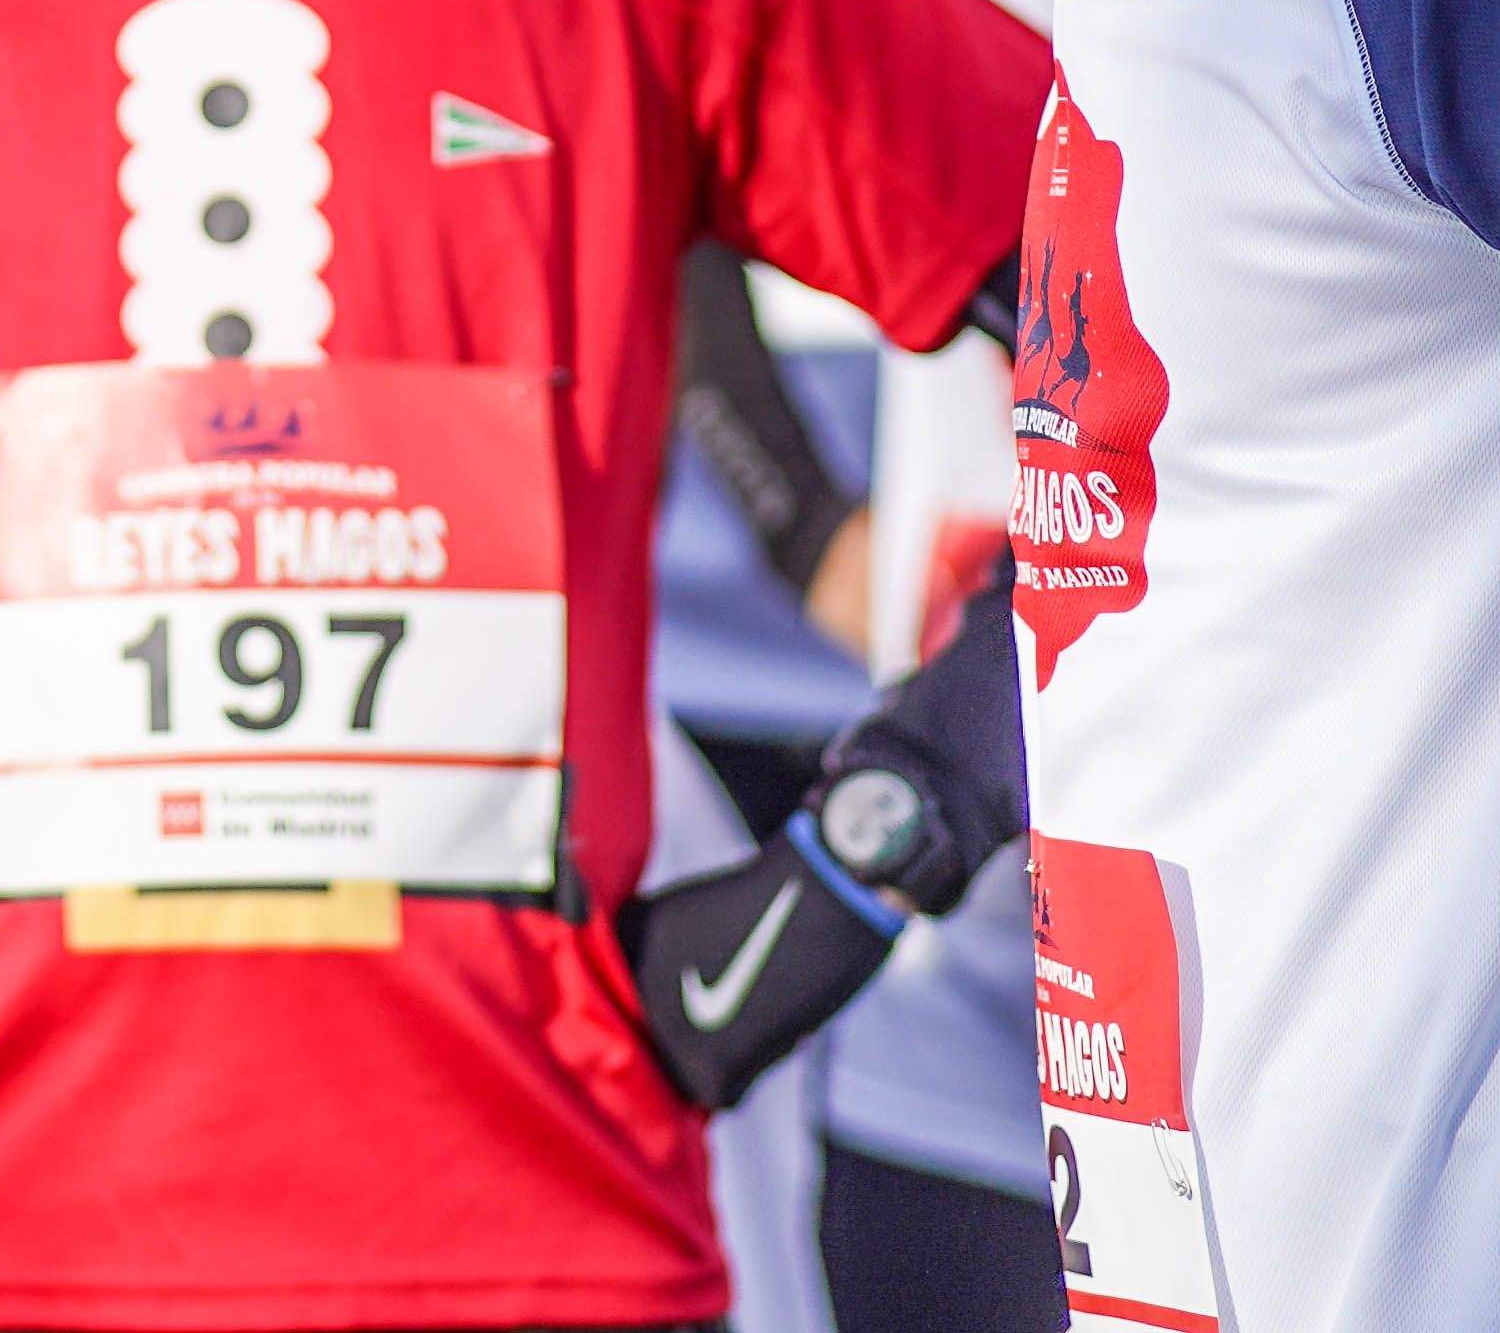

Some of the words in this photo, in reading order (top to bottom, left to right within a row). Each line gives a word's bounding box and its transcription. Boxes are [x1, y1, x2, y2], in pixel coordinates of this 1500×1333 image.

[1026, 407, 1079, 449] POPULAR
[254, 504, 449, 584] MAGOS
[1017, 466, 1125, 546] MAGOS
[1043, 565, 1129, 590] MADRID
[122, 613, 408, 733] 197
[1043, 1011, 1127, 1103] MAGOS
